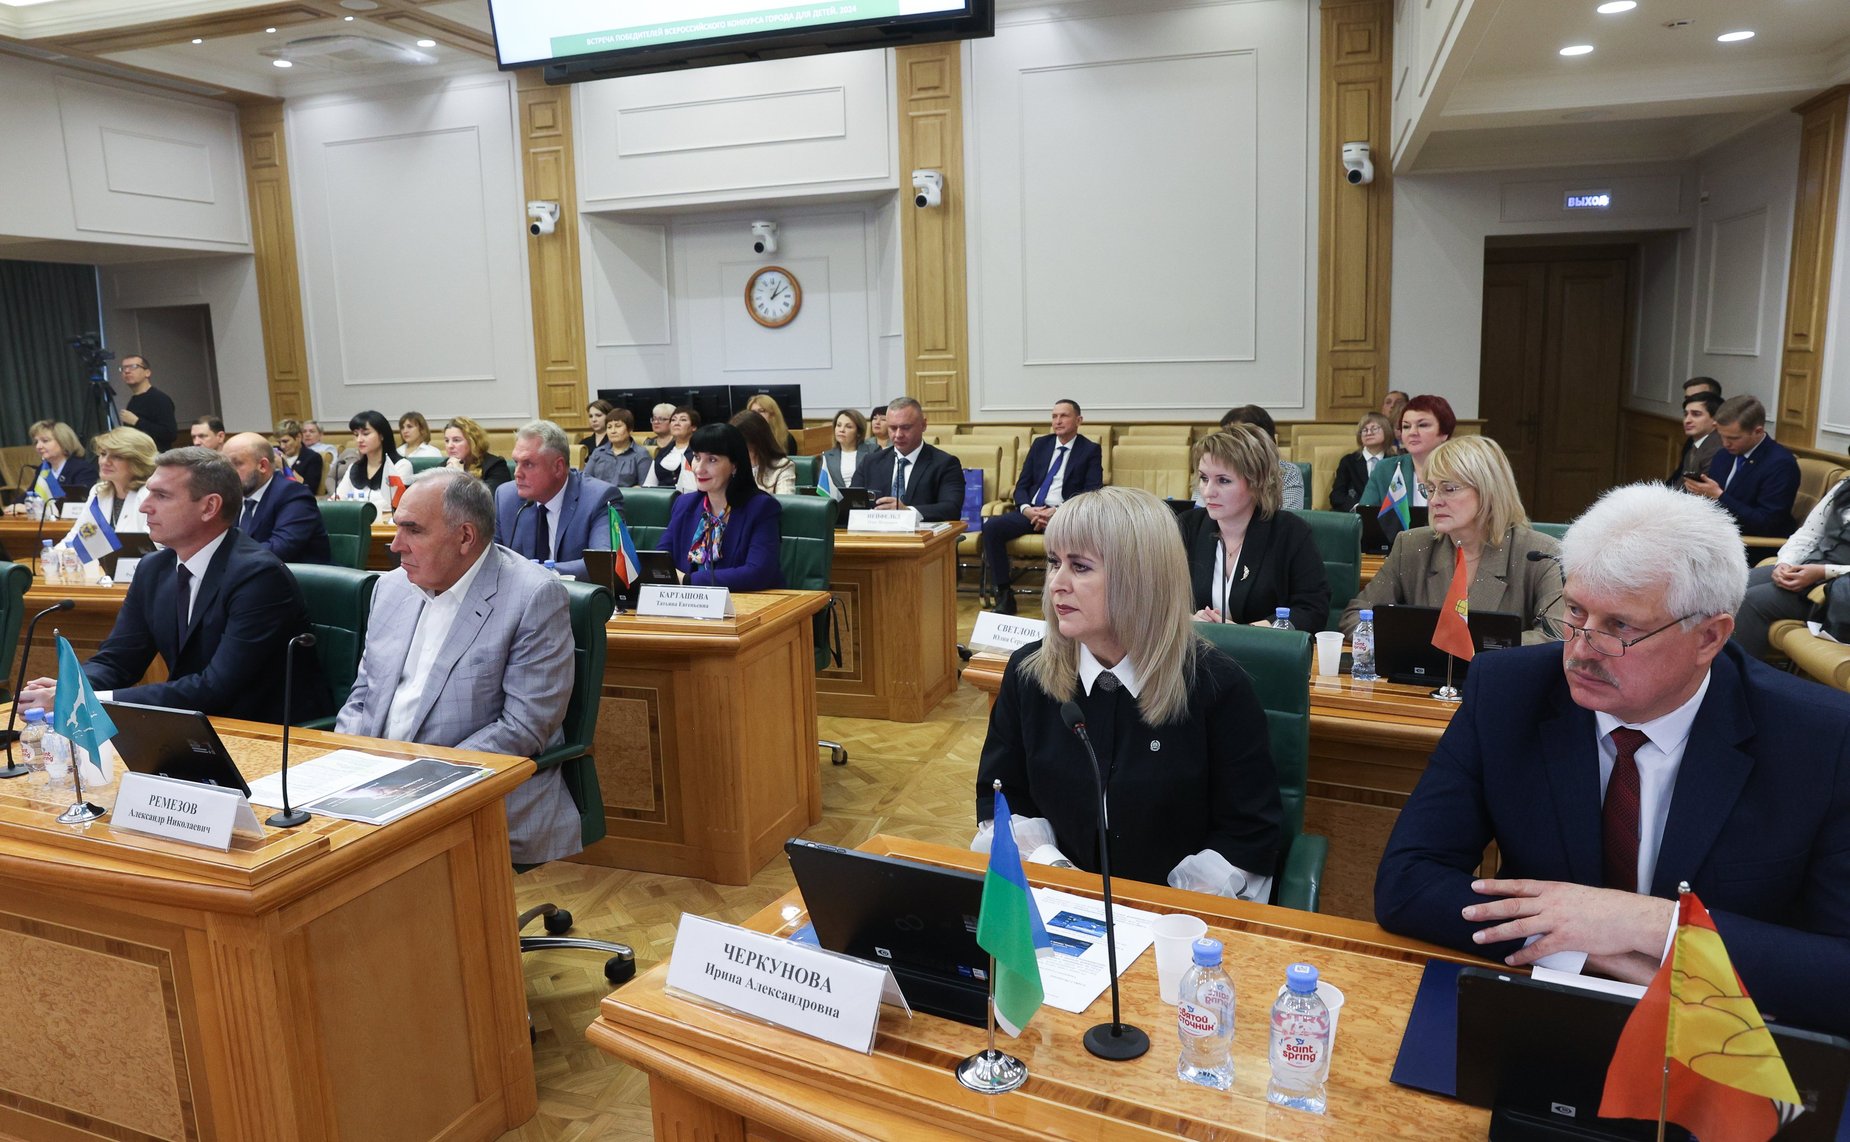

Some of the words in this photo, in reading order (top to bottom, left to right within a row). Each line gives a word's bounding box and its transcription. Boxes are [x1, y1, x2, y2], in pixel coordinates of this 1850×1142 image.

[586, 35, 615, 46] ВСТРЕЧА
[615, 28, 663, 42] ПОБЕДИТЕЛЕЙ
[664, 21, 726, 36] ВСЕРОССИЙСКОГО
[727, 16, 763, 28] КОНКУРСА
[765, 13, 794, 24] ГОРОДА
[796, 11, 812, 21] ДЛЯ
[659, 591, 709, 600] КАРТАШОВА
[997, 623, 1041, 638] СВЕТЛОВА
[148, 794, 198, 815] РЕМЕЗОВ
[128, 808, 165, 825] Александр
[166, 815, 211, 833] Николаевич
[723, 942, 832, 993] ЧЕРКУНОВА
[704, 962, 742, 986] Ирина
[744, 977, 840, 1019] Александровна
[1282, 1050, 1317, 1063] spring
[1286, 1043, 1313, 1053] saint
